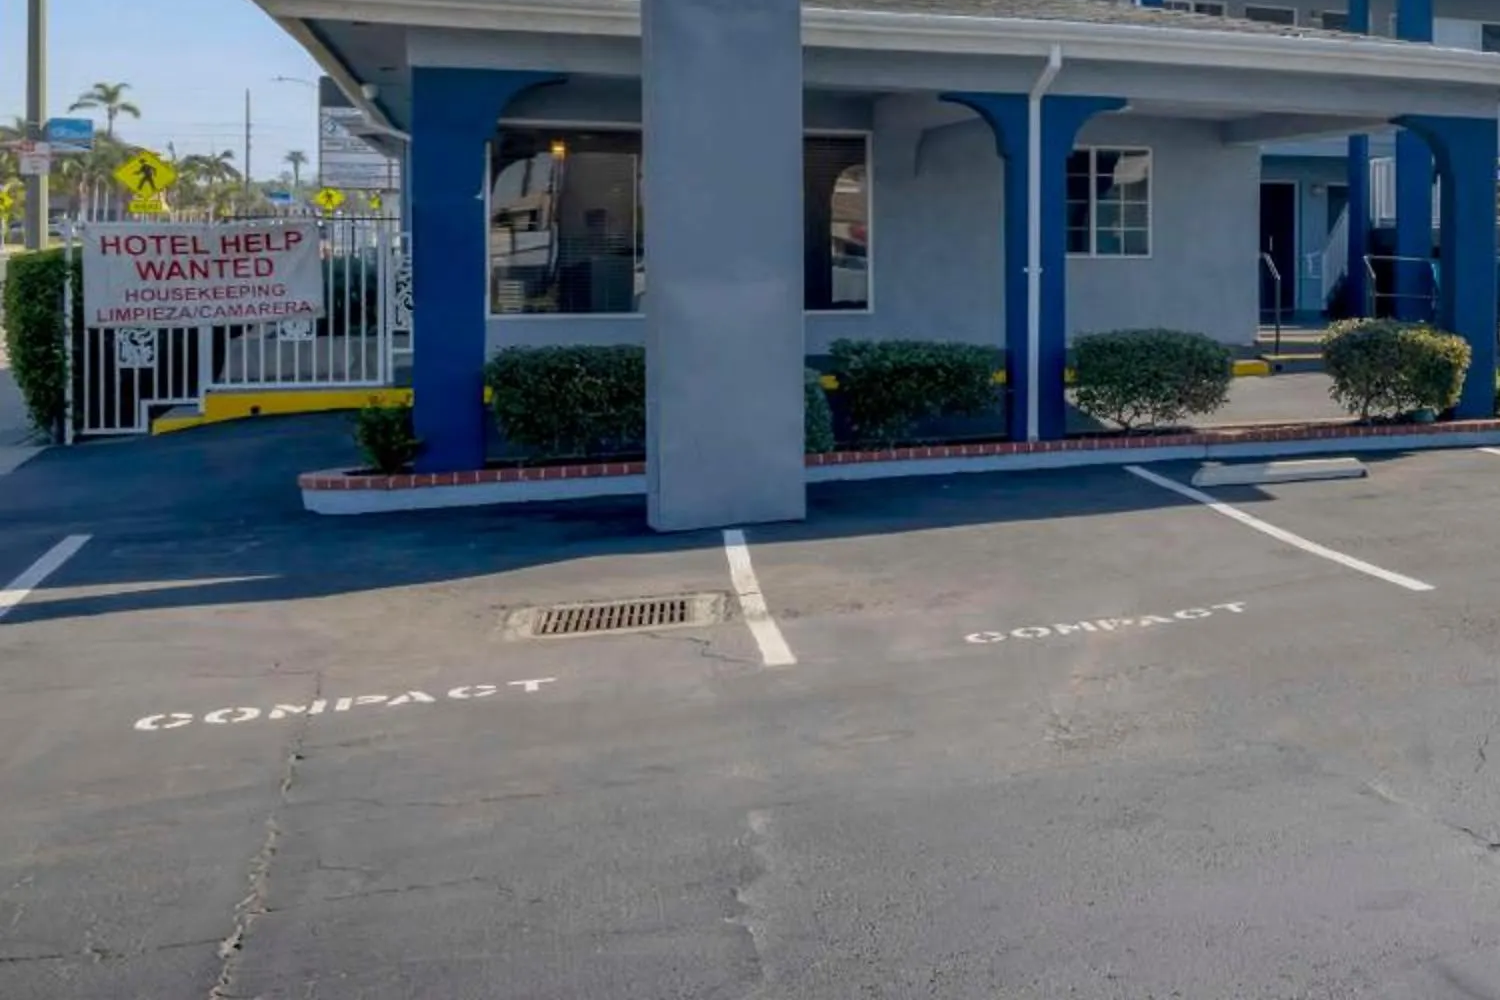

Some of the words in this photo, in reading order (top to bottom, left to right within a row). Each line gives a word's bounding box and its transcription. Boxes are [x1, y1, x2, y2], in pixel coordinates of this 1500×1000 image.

[100, 234, 210, 256] HOTEL
[220, 230, 303, 254] HELP
[135, 257, 275, 281] WANTED
[125, 283, 286, 303] HOUSEKEEPING
[96, 300, 313, 323] LIMPIEZA/CAMARERA
[133, 676, 557, 732] COMPACT
